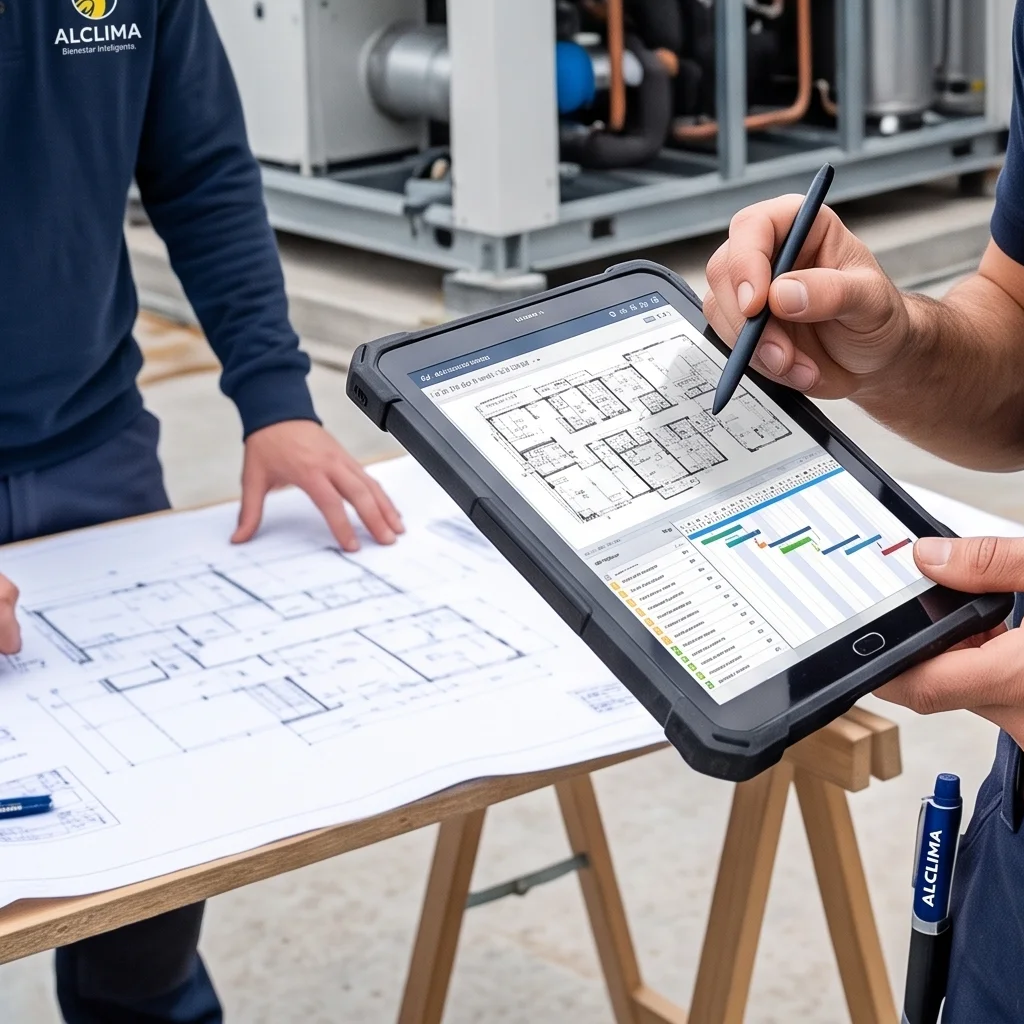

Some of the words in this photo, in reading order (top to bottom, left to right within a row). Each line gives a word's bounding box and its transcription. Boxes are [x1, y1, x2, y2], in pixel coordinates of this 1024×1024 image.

[54, 23, 142, 45] ALCLIMA
[62, 46, 96, 56] Bienestar
[921, 829, 943, 908] ALCLIMA
